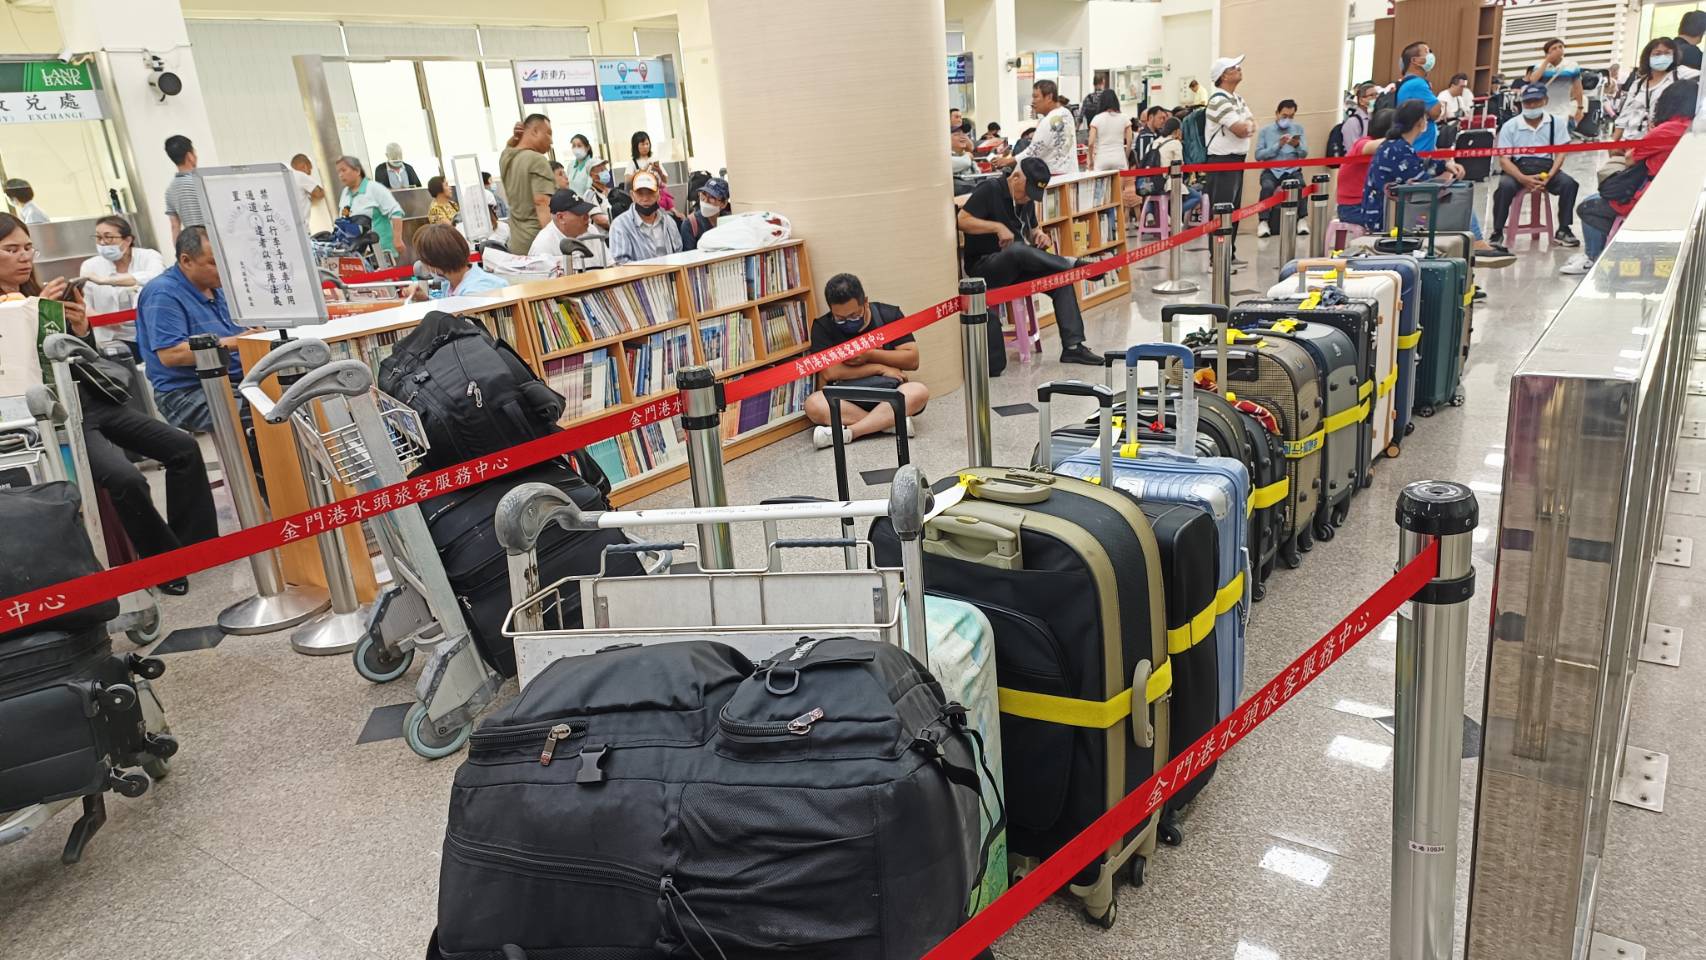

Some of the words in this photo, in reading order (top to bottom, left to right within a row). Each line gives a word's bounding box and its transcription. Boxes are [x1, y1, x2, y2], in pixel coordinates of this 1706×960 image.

[41, 68, 81, 79] LAND
[43, 77, 84, 87] BANK
[28, 112, 86, 121] EXCHANGE
[629, 395, 683, 428] 金門港水
[280, 457, 509, 543] 金門港水頭旅客服務中心
[1145, 611, 1371, 814] 金門港水頭旅客服務中心
